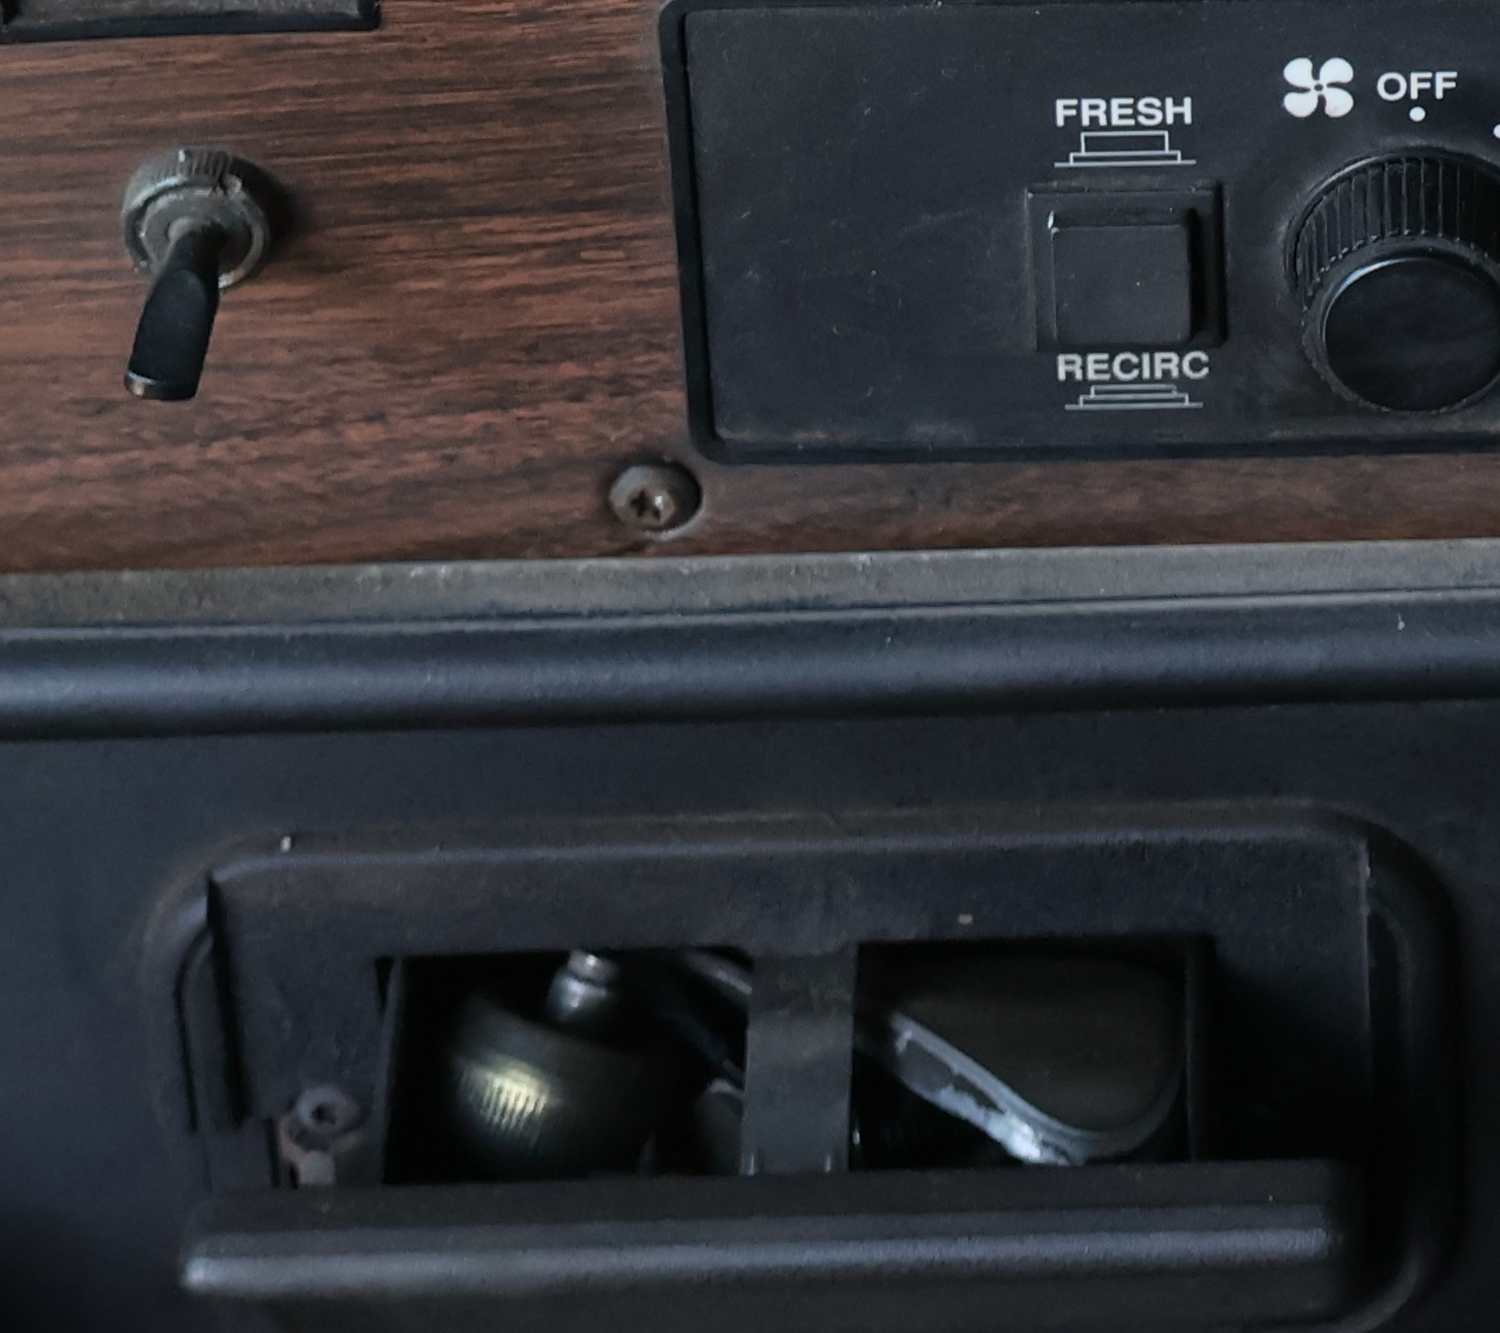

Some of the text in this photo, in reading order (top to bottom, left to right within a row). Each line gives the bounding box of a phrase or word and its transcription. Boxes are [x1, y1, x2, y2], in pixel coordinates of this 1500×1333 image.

[1376, 71, 1458, 101] OFF
[1055, 96, 1193, 128] FRESH
[1056, 350, 1210, 382] RECIRC
